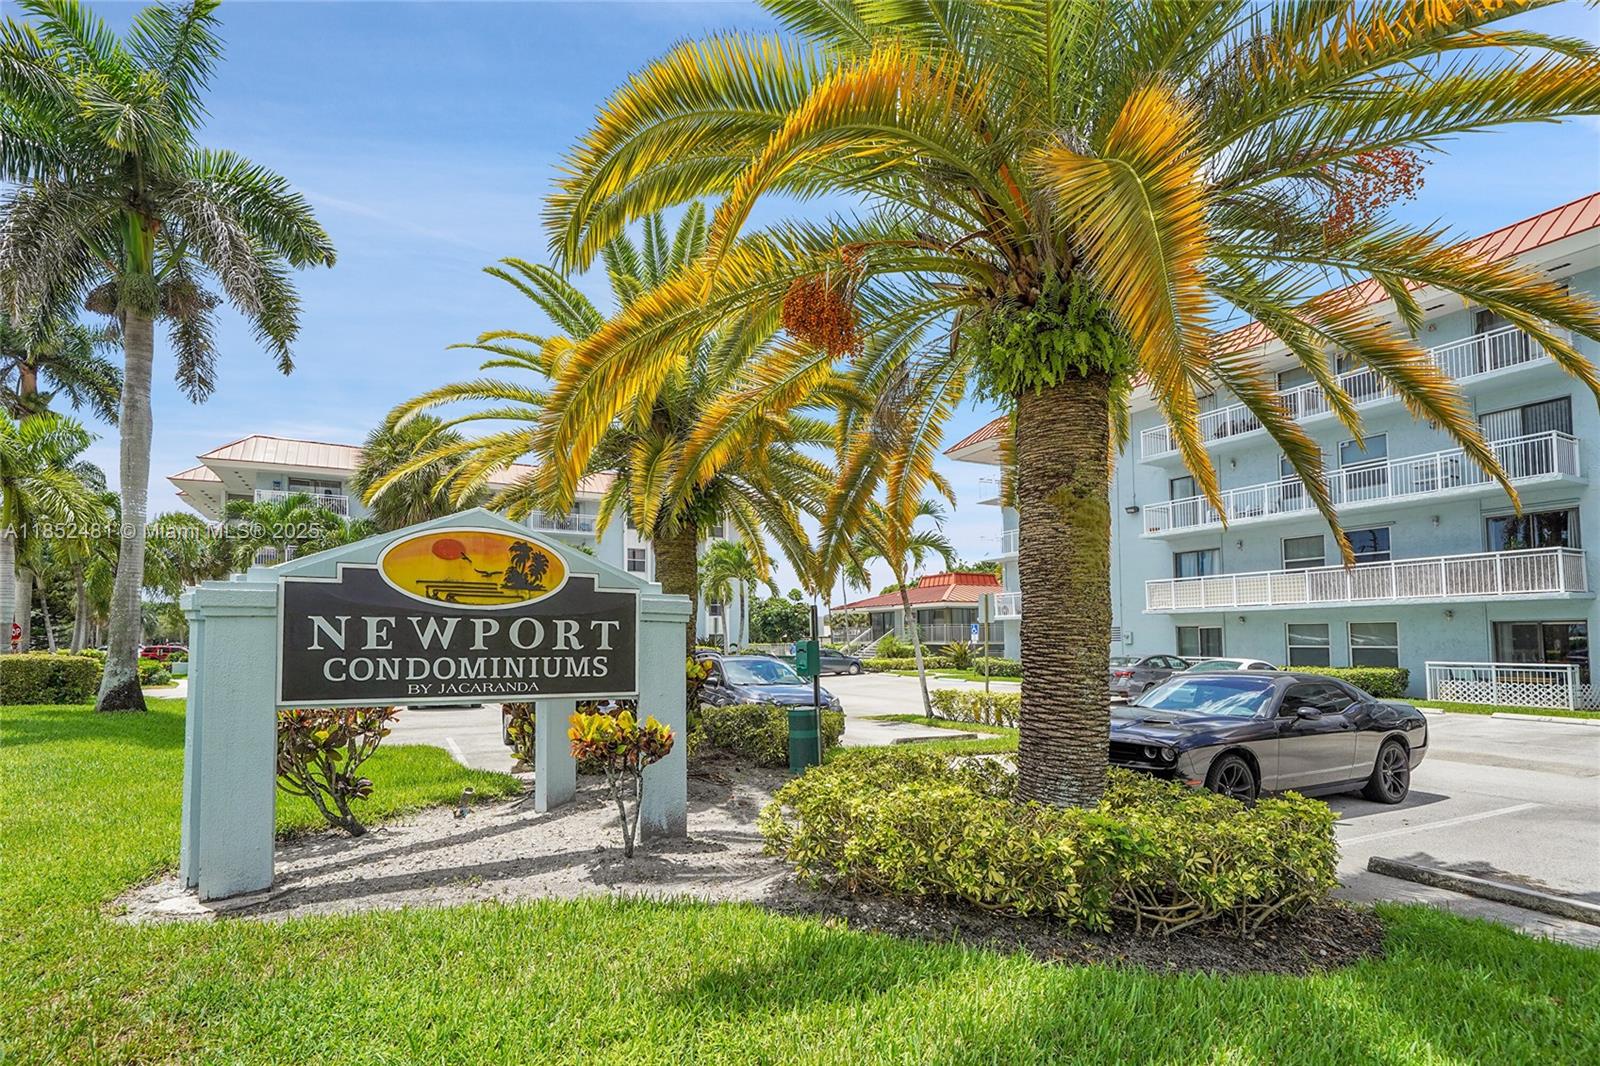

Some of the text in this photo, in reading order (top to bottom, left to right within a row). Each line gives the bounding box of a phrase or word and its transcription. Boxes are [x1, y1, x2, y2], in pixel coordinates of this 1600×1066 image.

[308, 615, 620, 651] NEWPORT
[323, 656, 609, 682] CONDOMINIUMS
[408, 682, 540, 695] BY JACARANDA
